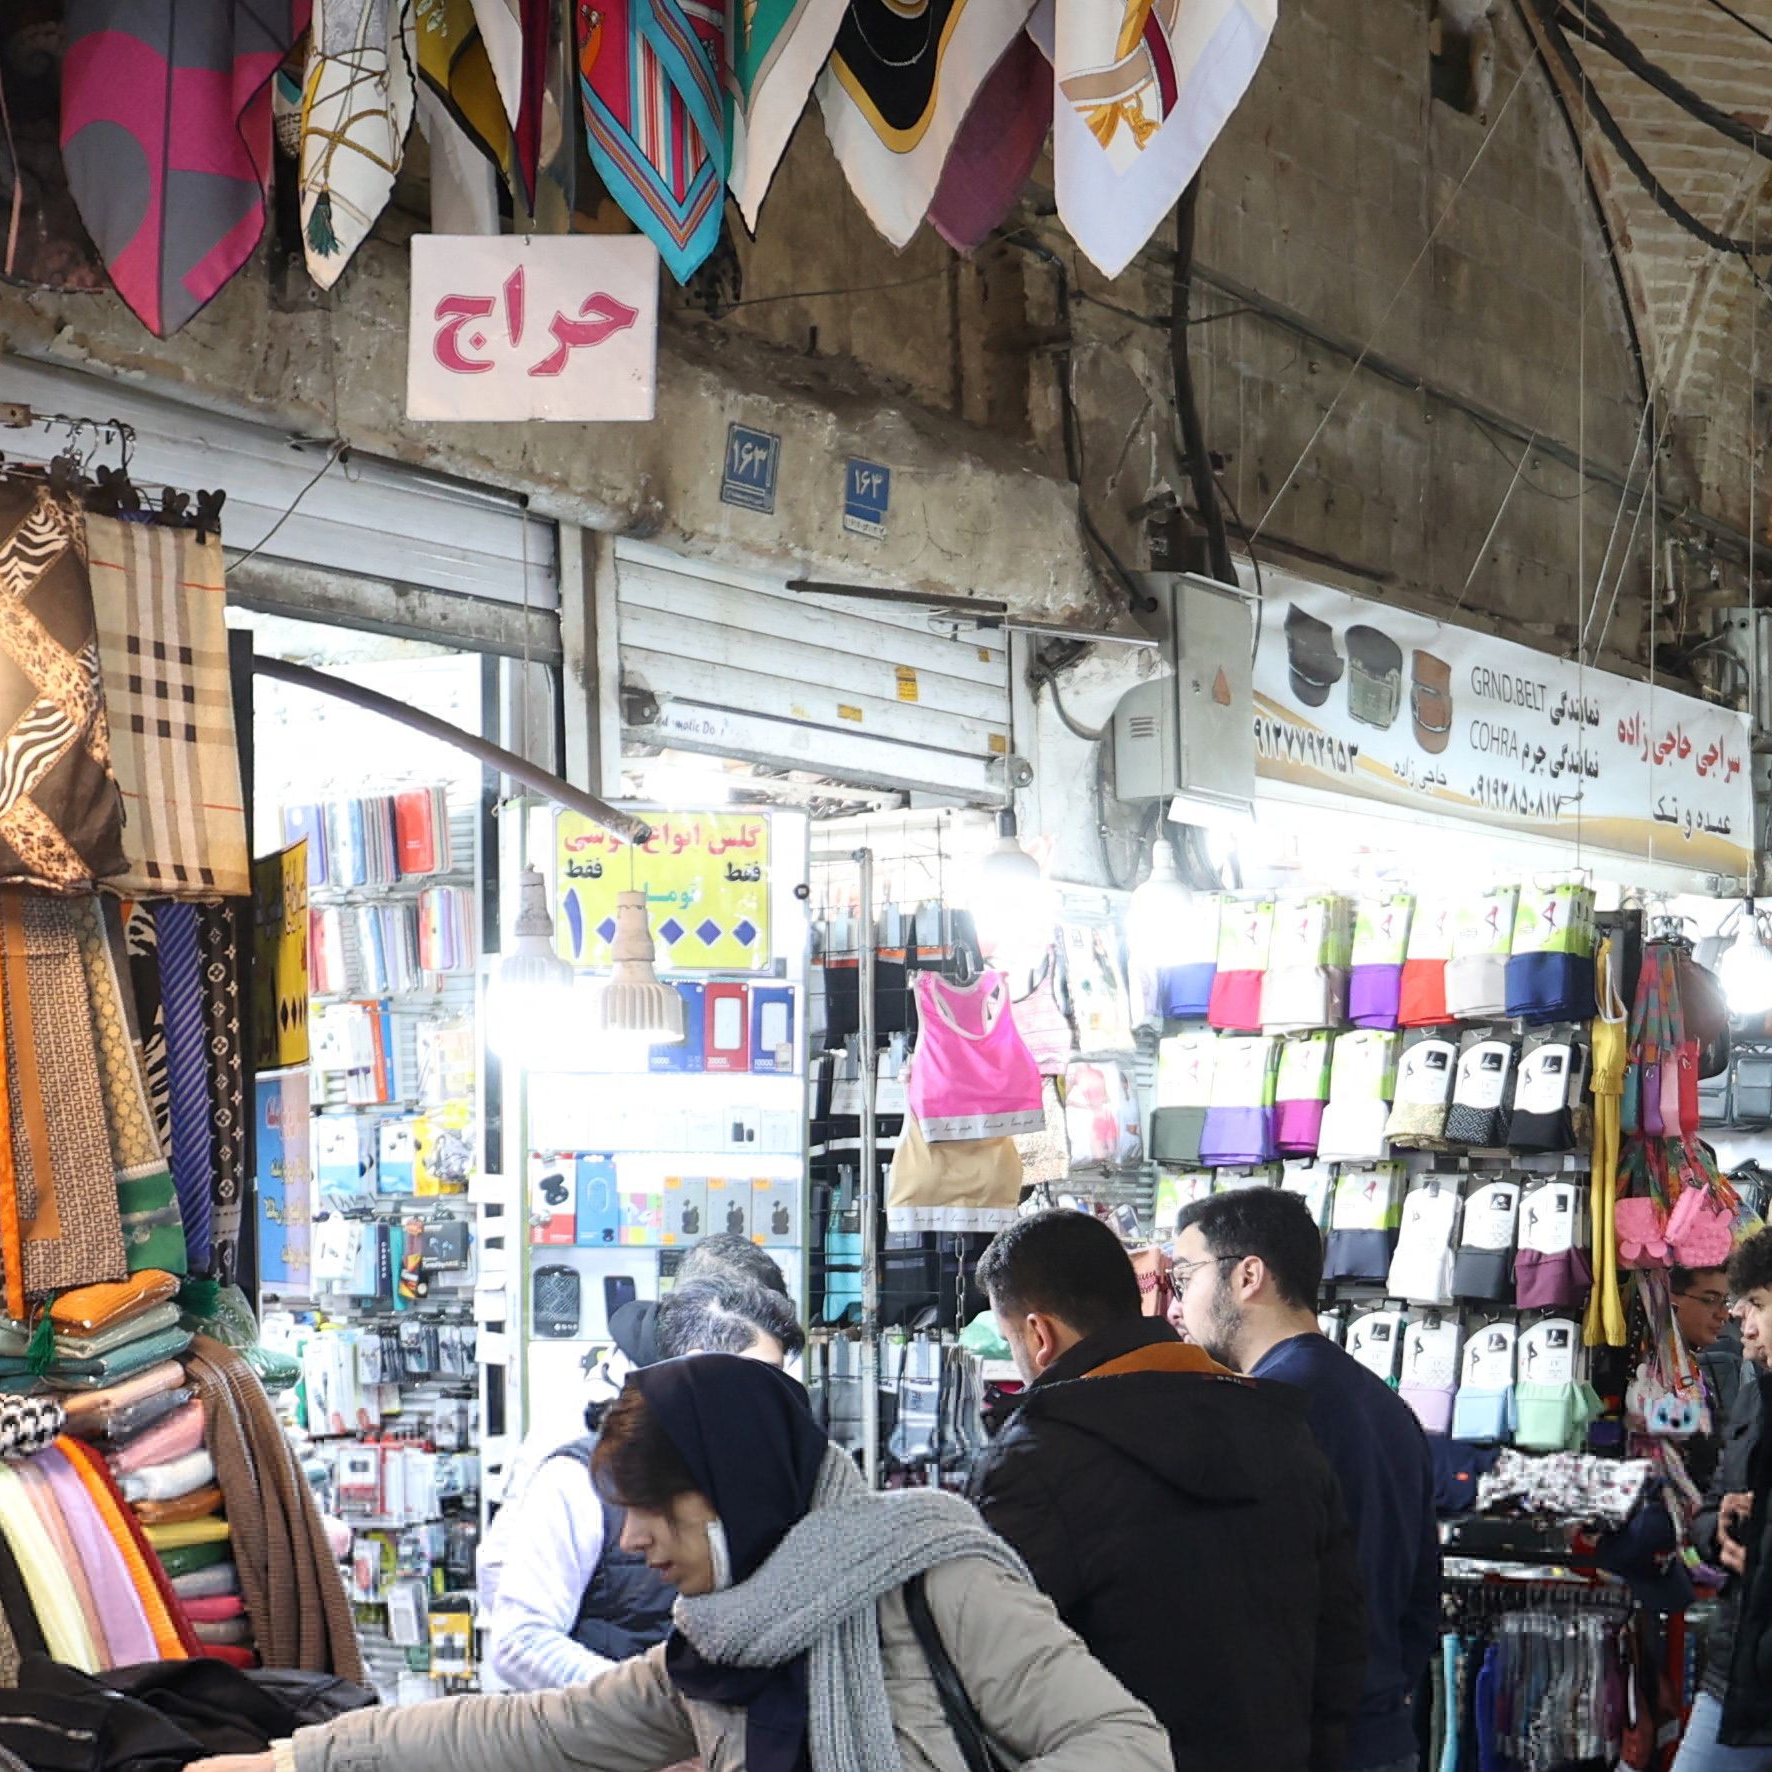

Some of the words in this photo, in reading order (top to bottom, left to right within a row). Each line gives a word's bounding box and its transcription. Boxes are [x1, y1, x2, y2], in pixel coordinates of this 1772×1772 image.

[433, 264, 639, 377] حراج
[732, 440, 769, 480] ۱۶۳
[854, 468, 883, 499] ۱۶۳
[1471, 666, 1547, 712] GRND.BELT
[1549, 690, 1600, 731] نمایندگی
[1469, 720, 1518, 760] COHRA
[1617, 711, 1649, 762] زاده
[1652, 722, 1692, 768] حاجی
[1393, 756, 1418, 787] زاده
[1521, 743, 1547, 777] چرم
[1549, 743, 1599, 782] نمایندگی
[1695, 735, 1741, 783] سراجی
[1419, 763, 1448, 789] حاجی
[1652, 795, 1679, 823] تک
[1684, 809, 1693, 839] و
[1696, 811, 1731, 835] عمده
[564, 824, 630, 853] وشی
[642, 823, 700, 854] انواع
[708, 824, 761, 855] گلس
[565, 858, 603, 879] فقط
[724, 862, 761, 883] فقط
[643, 882, 698, 910] توما
